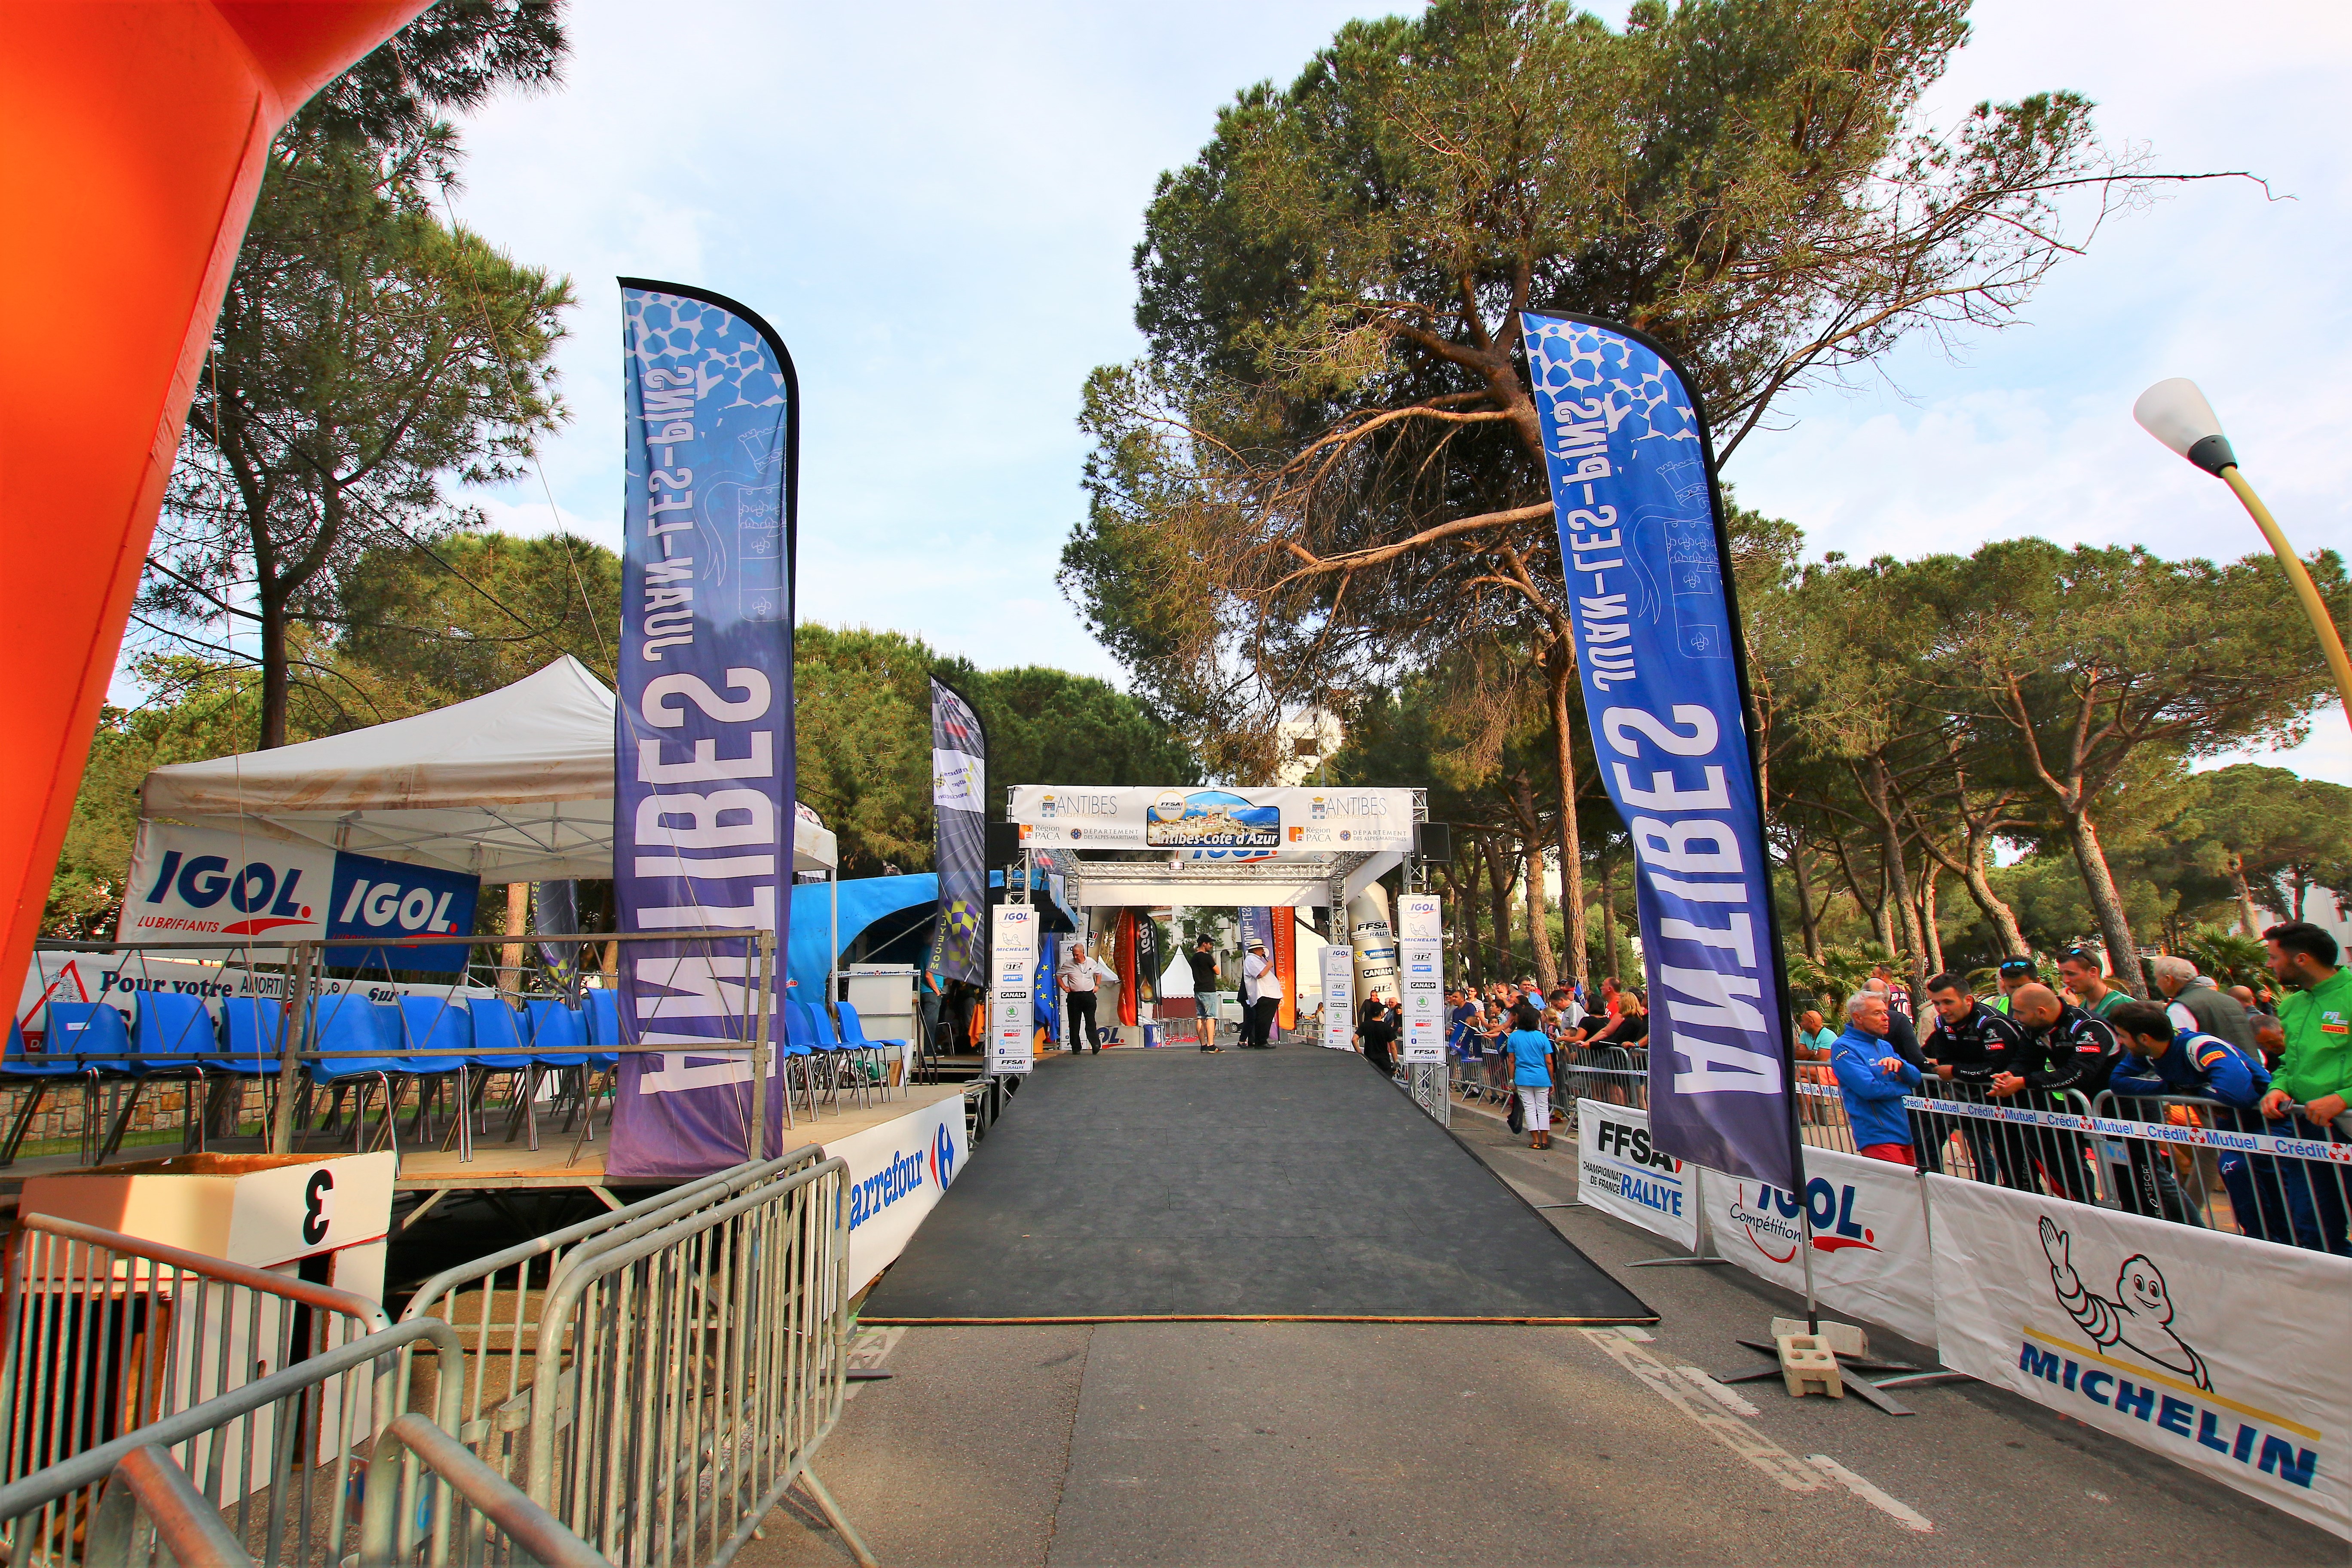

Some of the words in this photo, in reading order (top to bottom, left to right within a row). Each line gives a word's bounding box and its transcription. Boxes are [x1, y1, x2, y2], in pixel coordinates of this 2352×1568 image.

[1057, 795, 1118, 815] ANTIBES
[1325, 797, 1387, 816] ANTIBES
[1035, 824, 1060, 833] Région
[1035, 832, 1061, 840] PACA
[1306, 826, 1331, 835] Région
[1306, 834, 1332, 842] PACA
[1150, 832, 1229, 845] Antibes-Côte
[1235, 832, 1277, 845] d'Azur
[137, 915, 220, 934] LUBRIFIANTS
[1364, 968, 1393, 977] CANAL+
[99, 971, 168, 993] Pour
[172, 978, 233, 998] votre
[1902, 1097, 1923, 1109] Crédit
[1932, 1100, 1959, 1113] Mutuel
[1967, 1105, 1994, 1118] Crédit
[2004, 1109, 2037, 1123] Mutuel
[2047, 1114, 2080, 1129] Crédit
[2092, 1118, 2134, 1135] Mutuel
[2147, 1125, 2190, 1142] Crédit
[2205, 1131, 2258, 1150] Mutuel
[2275, 1139, 2329, 1159] Crédit
[1583, 1161, 1623, 1182] CHAMPIONNAT
[1621, 1173, 1683, 1217] RALLYE
[1590, 1175, 1600, 1187] DE
[1601, 1179, 1620, 1195] FRANCE
[1730, 1202, 1802, 1243] Compétition
[2018, 1341, 2318, 1490] MICHELIN
